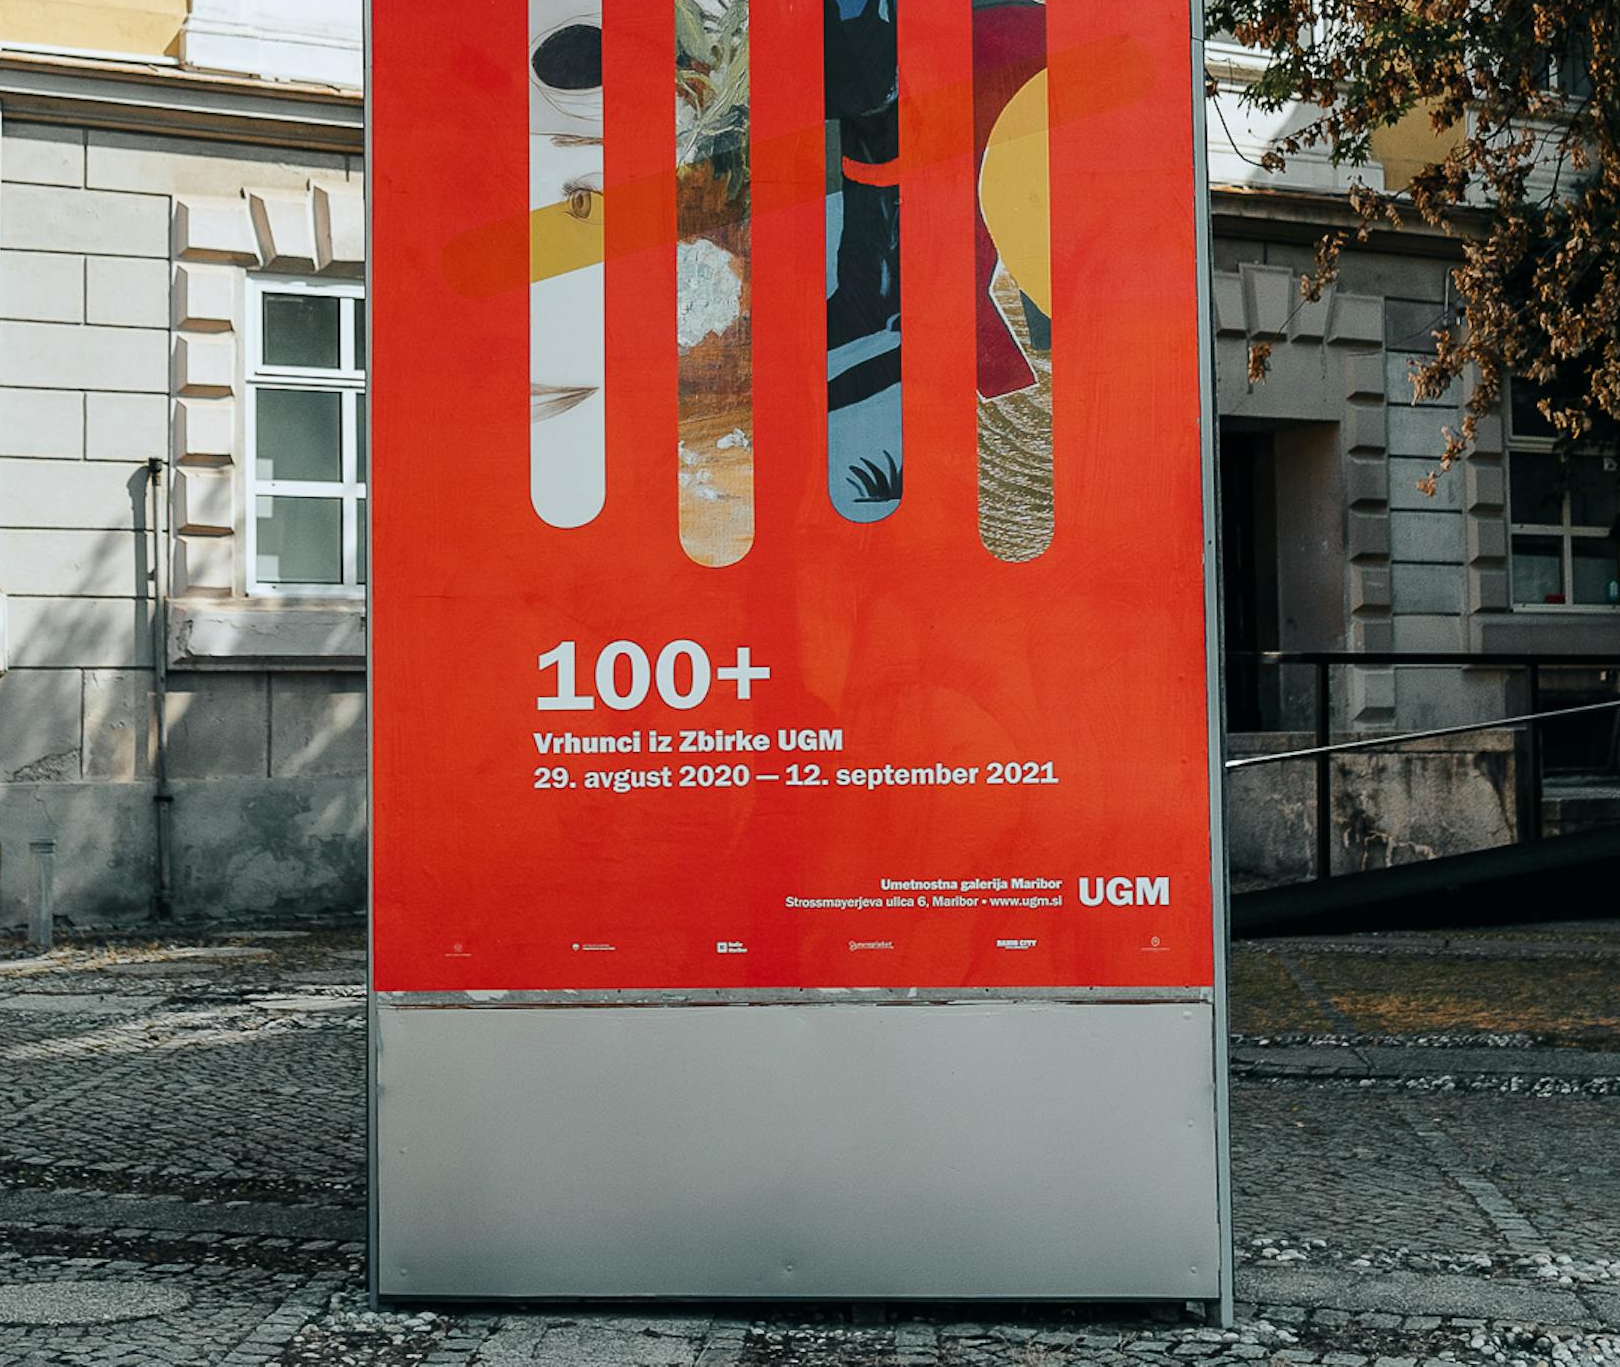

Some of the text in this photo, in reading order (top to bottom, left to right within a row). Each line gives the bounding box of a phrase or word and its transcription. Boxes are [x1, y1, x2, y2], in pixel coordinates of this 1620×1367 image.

[536, 639, 771, 711] 100+
[533, 728, 844, 754] Vrhunci iz Zbirke UGM
[533, 767, 577, 789] 29.
[584, 766, 673, 793] avgust
[679, 765, 750, 787] 2020
[785, 763, 829, 786] 12.
[835, 762, 980, 790] september
[986, 760, 1060, 784] 2021
[880, 877, 1063, 892] Umetnostna galerija Maribor
[1078, 876, 1170, 907] UGM
[785, 894, 1063, 910] Strossmayerjeva ulica 6, Maribor www.ugm.si
